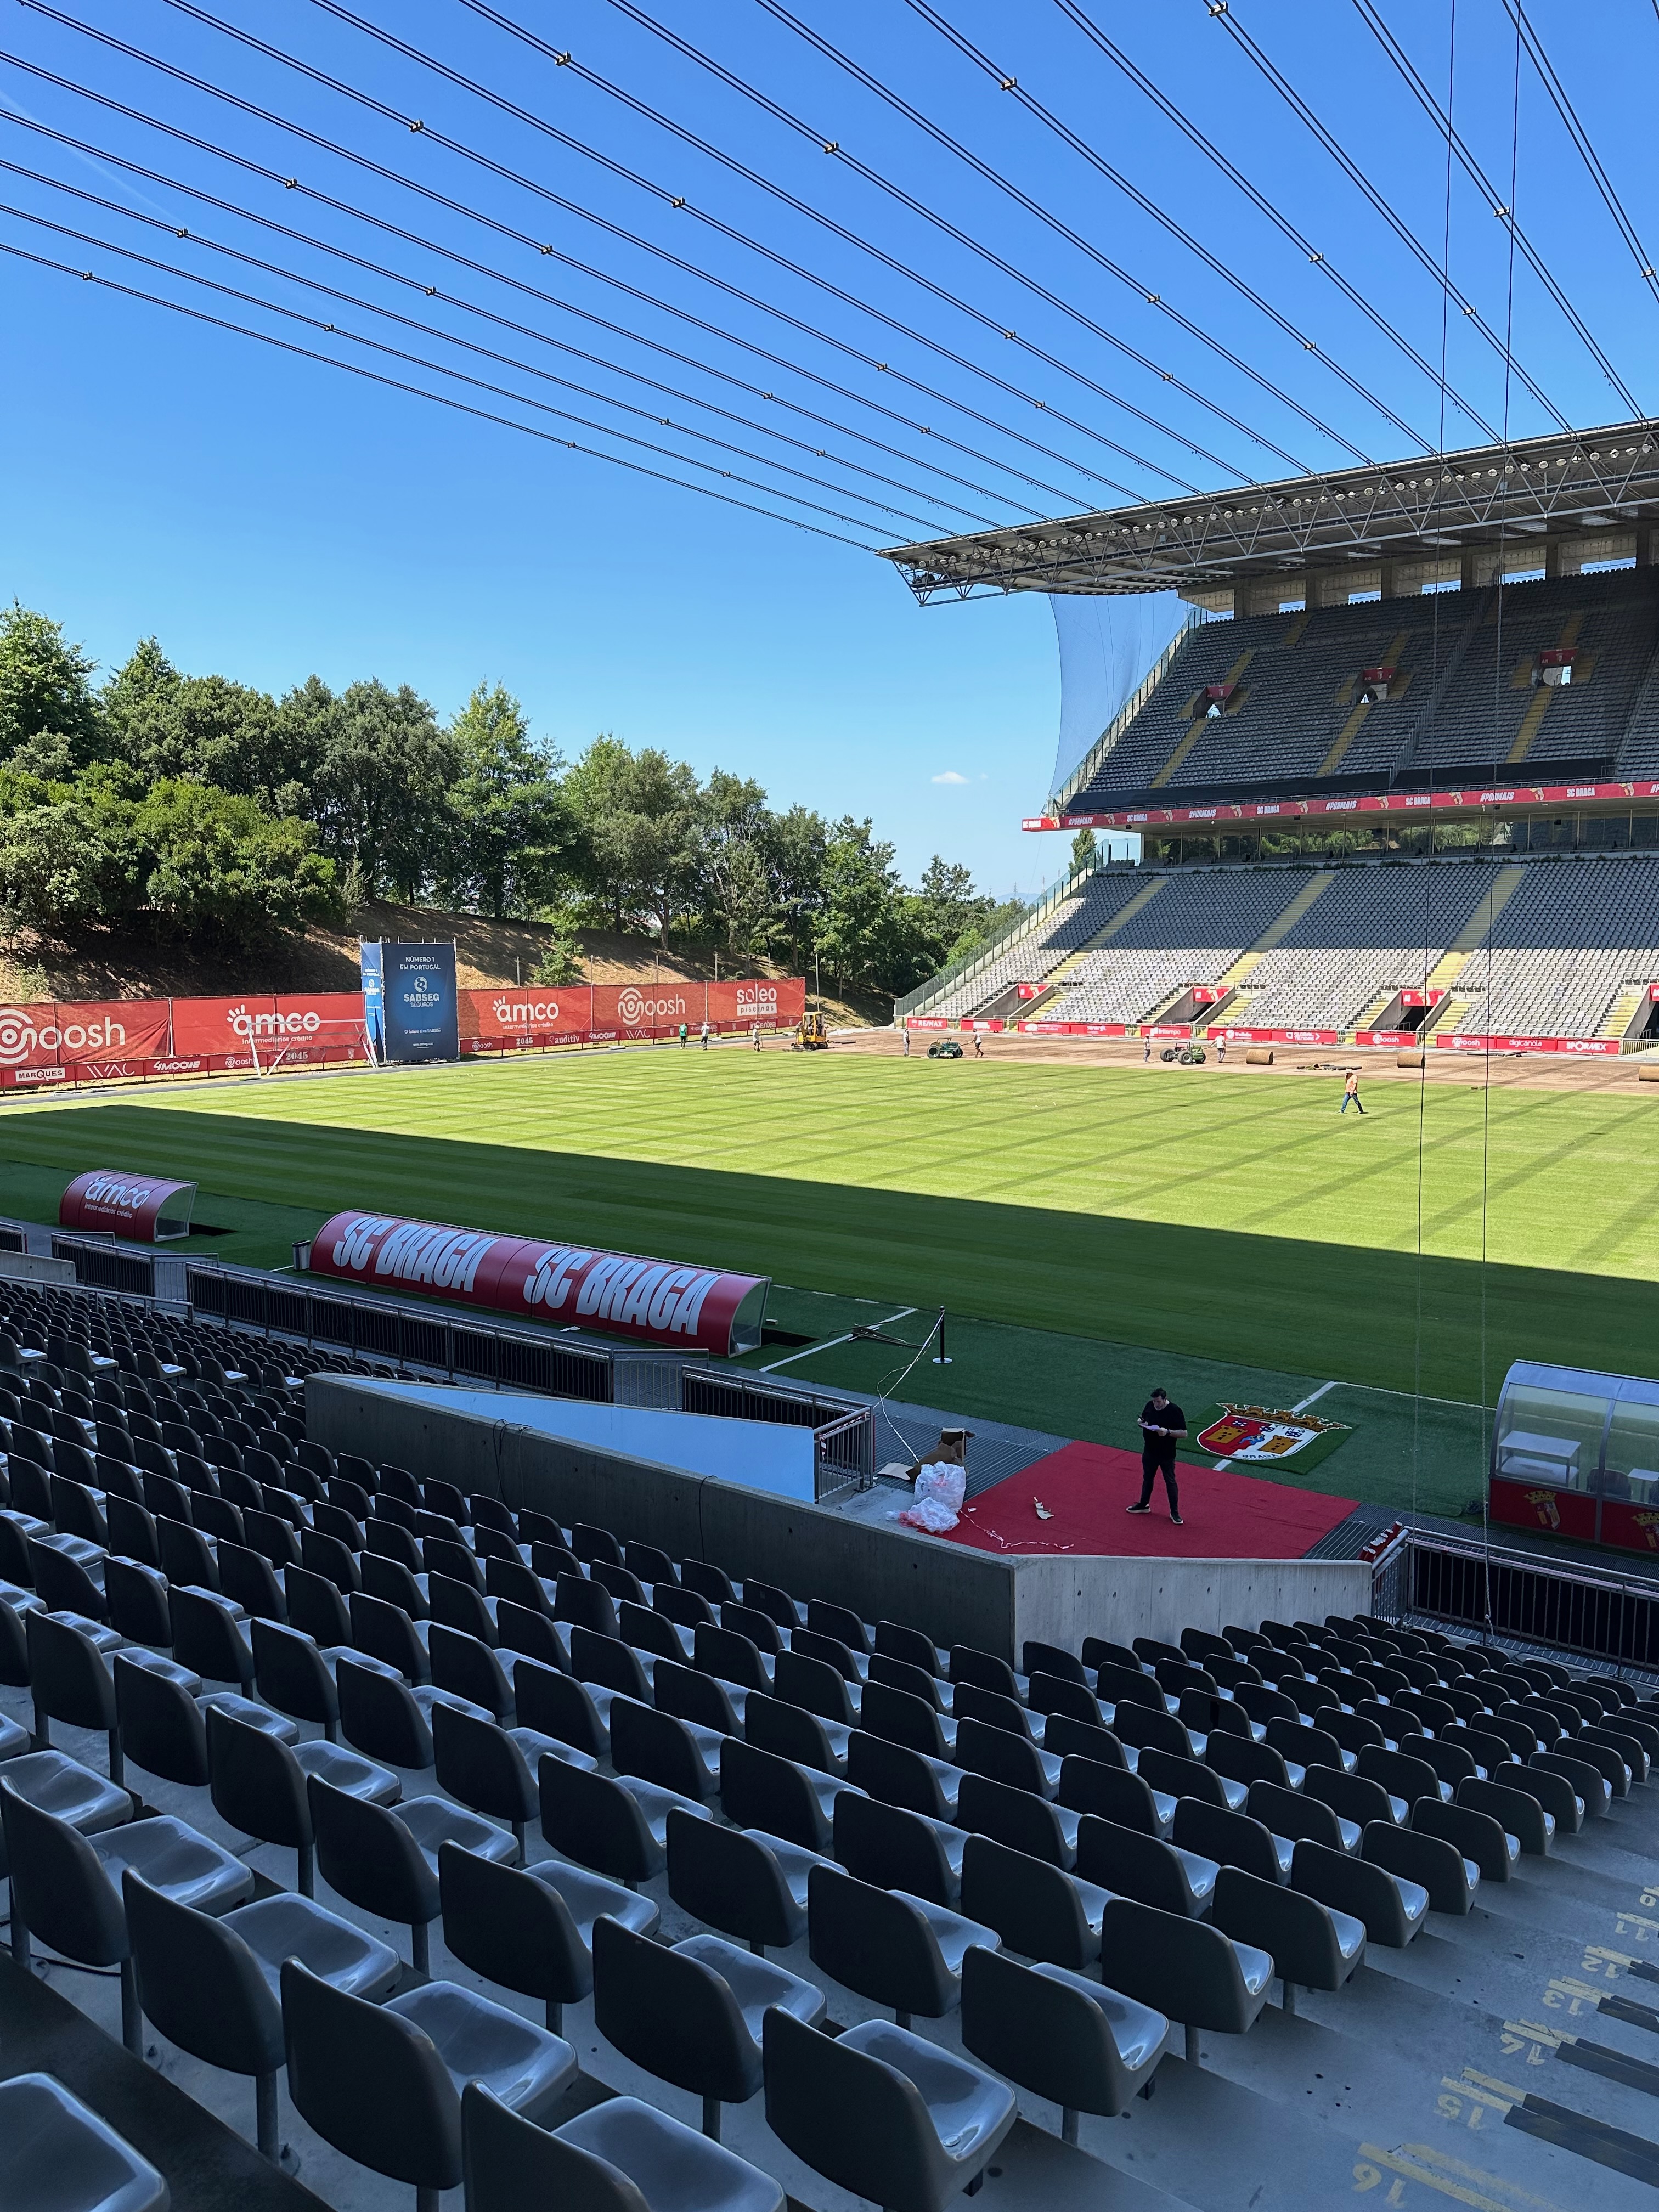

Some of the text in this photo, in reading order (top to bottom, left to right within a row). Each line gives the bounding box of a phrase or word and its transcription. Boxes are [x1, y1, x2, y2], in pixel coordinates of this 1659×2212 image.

[1480, 792, 1515, 802] #PORMAIS
[1567, 787, 1595, 797] SC BRAGA
[1325, 800, 1357, 810] #PORMAIS
[1406, 796, 1431, 805] SC BRAGA
[1263, 805, 1280, 814] BRAGA
[403, 993, 439, 1002] SABSEG
[736, 988, 777, 1003] soleo
[496, 1002, 559, 1023] amco
[740, 1006, 774, 1014] piscinas
[233, 1012, 321, 1036] amco
[516, 1037, 533, 1045] 2045
[555, 1035, 580, 1044] auditiv
[285, 1051, 308, 1060] 2045
[19, 1070, 63, 1080] MARQUES
[84, 1181, 151, 1209] amco
[332, 1216, 500, 1293] SC BRAGA
[523, 1248, 722, 1336] SC BRAGA
[1615, 1920, 1649, 1941] 11
[1581, 1954, 1621, 1979] 12
[1542, 1989, 1584, 2016] 13
[1499, 2032, 1546, 2066] 14
[1434, 2094, 1485, 2131] 15
[1351, 2163, 1408, 2209] 16
